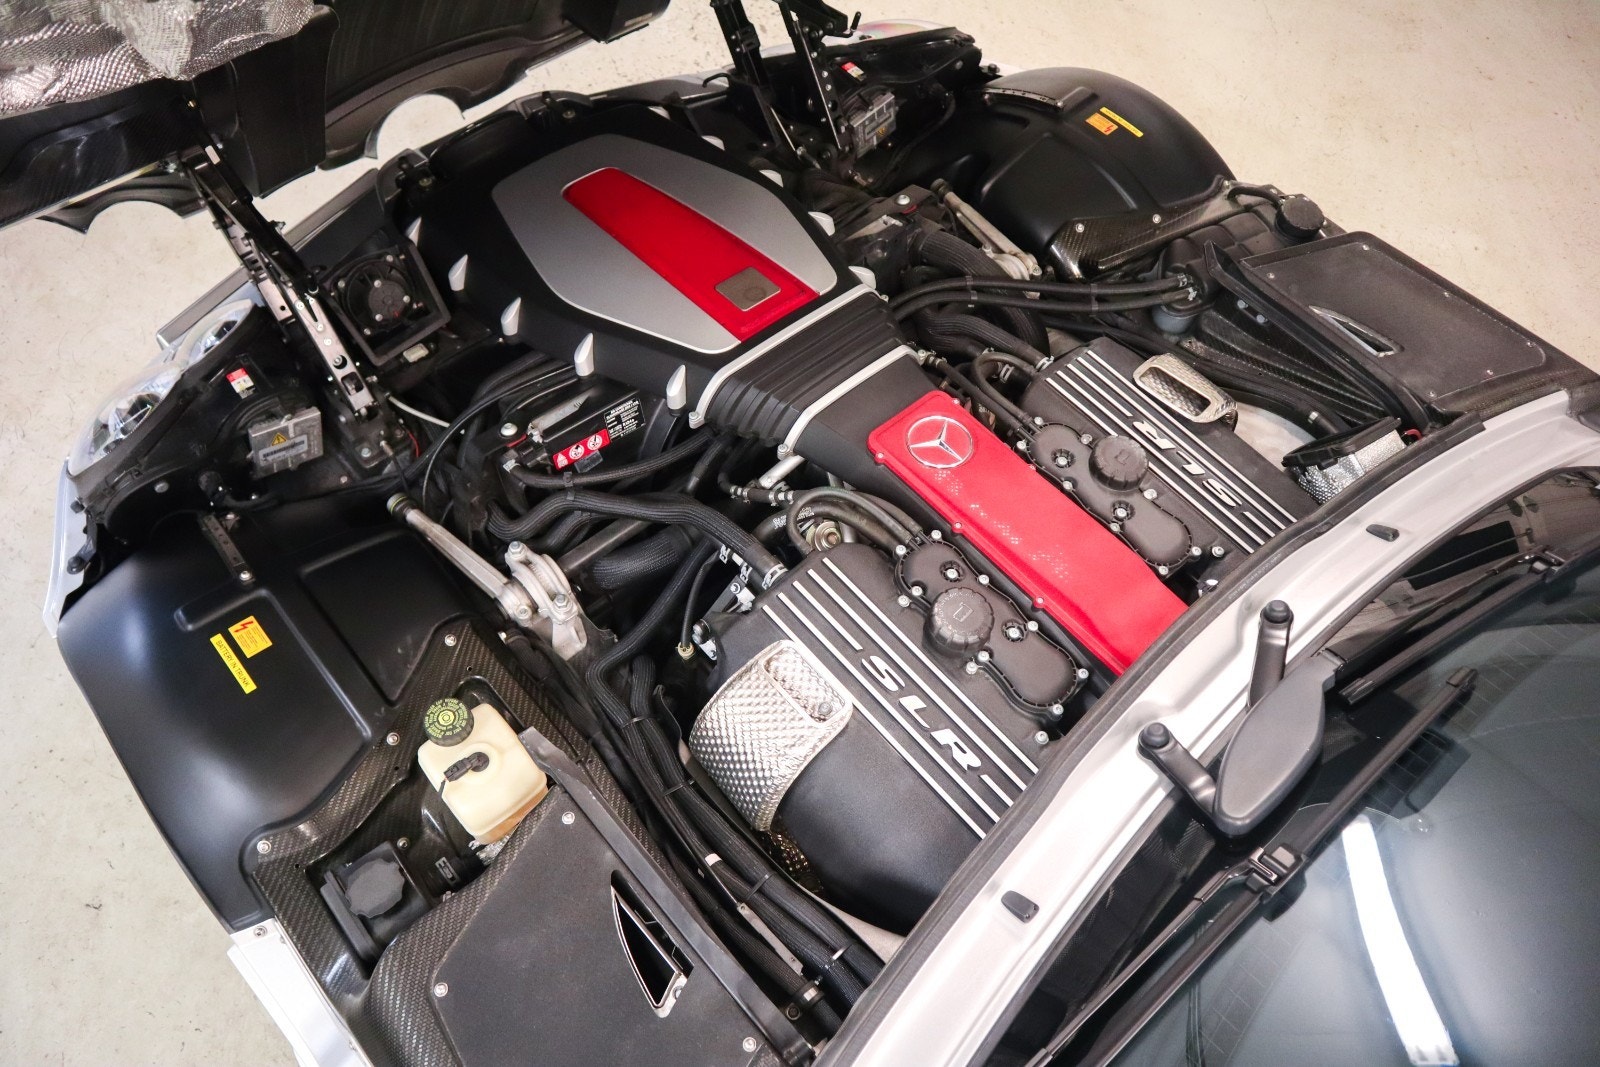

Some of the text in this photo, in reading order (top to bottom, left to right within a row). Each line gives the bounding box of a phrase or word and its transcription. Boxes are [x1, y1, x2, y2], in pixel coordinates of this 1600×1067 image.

[1132, 420, 1242, 507] SLR
[216, 640, 233, 662] BATTERY
[235, 667, 250, 687] TRUNK
[861, 655, 982, 773] SLR
